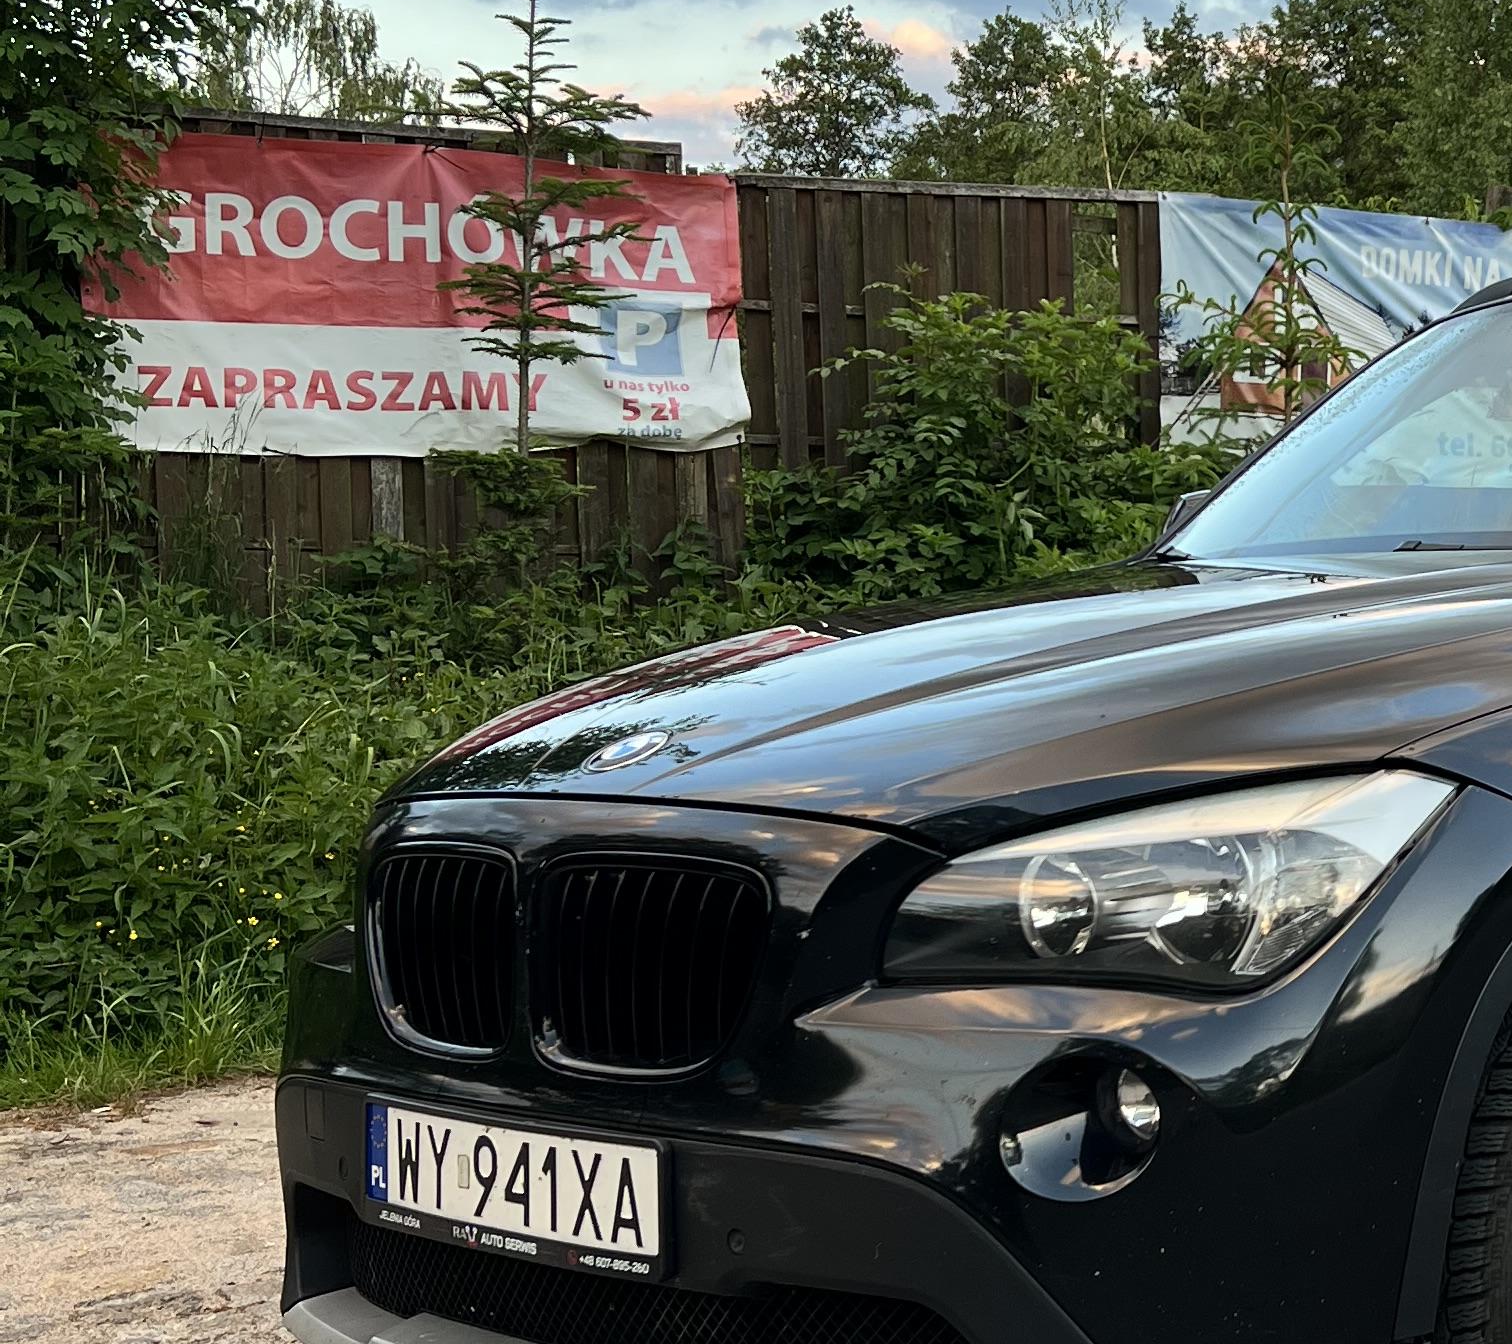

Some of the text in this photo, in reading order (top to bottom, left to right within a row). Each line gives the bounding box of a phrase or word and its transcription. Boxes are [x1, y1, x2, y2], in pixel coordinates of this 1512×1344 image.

[137, 189, 696, 285] GROCHÓWKA
[1360, 245, 1450, 287] DOMKI
[617, 309, 668, 366] P
[137, 365, 549, 412] ZAPRASZAMY
[603, 379, 690, 394] u nas tylko
[622, 396, 681, 422] 5 zł
[618, 426, 637, 438] za
[1438, 431, 1483, 457] tel.
[371, 1164, 386, 1189] PL
[397, 1118, 644, 1248] WY 941XA
[480, 1232, 504, 1249] AUTO
[504, 1237, 537, 1256] SERWIS
